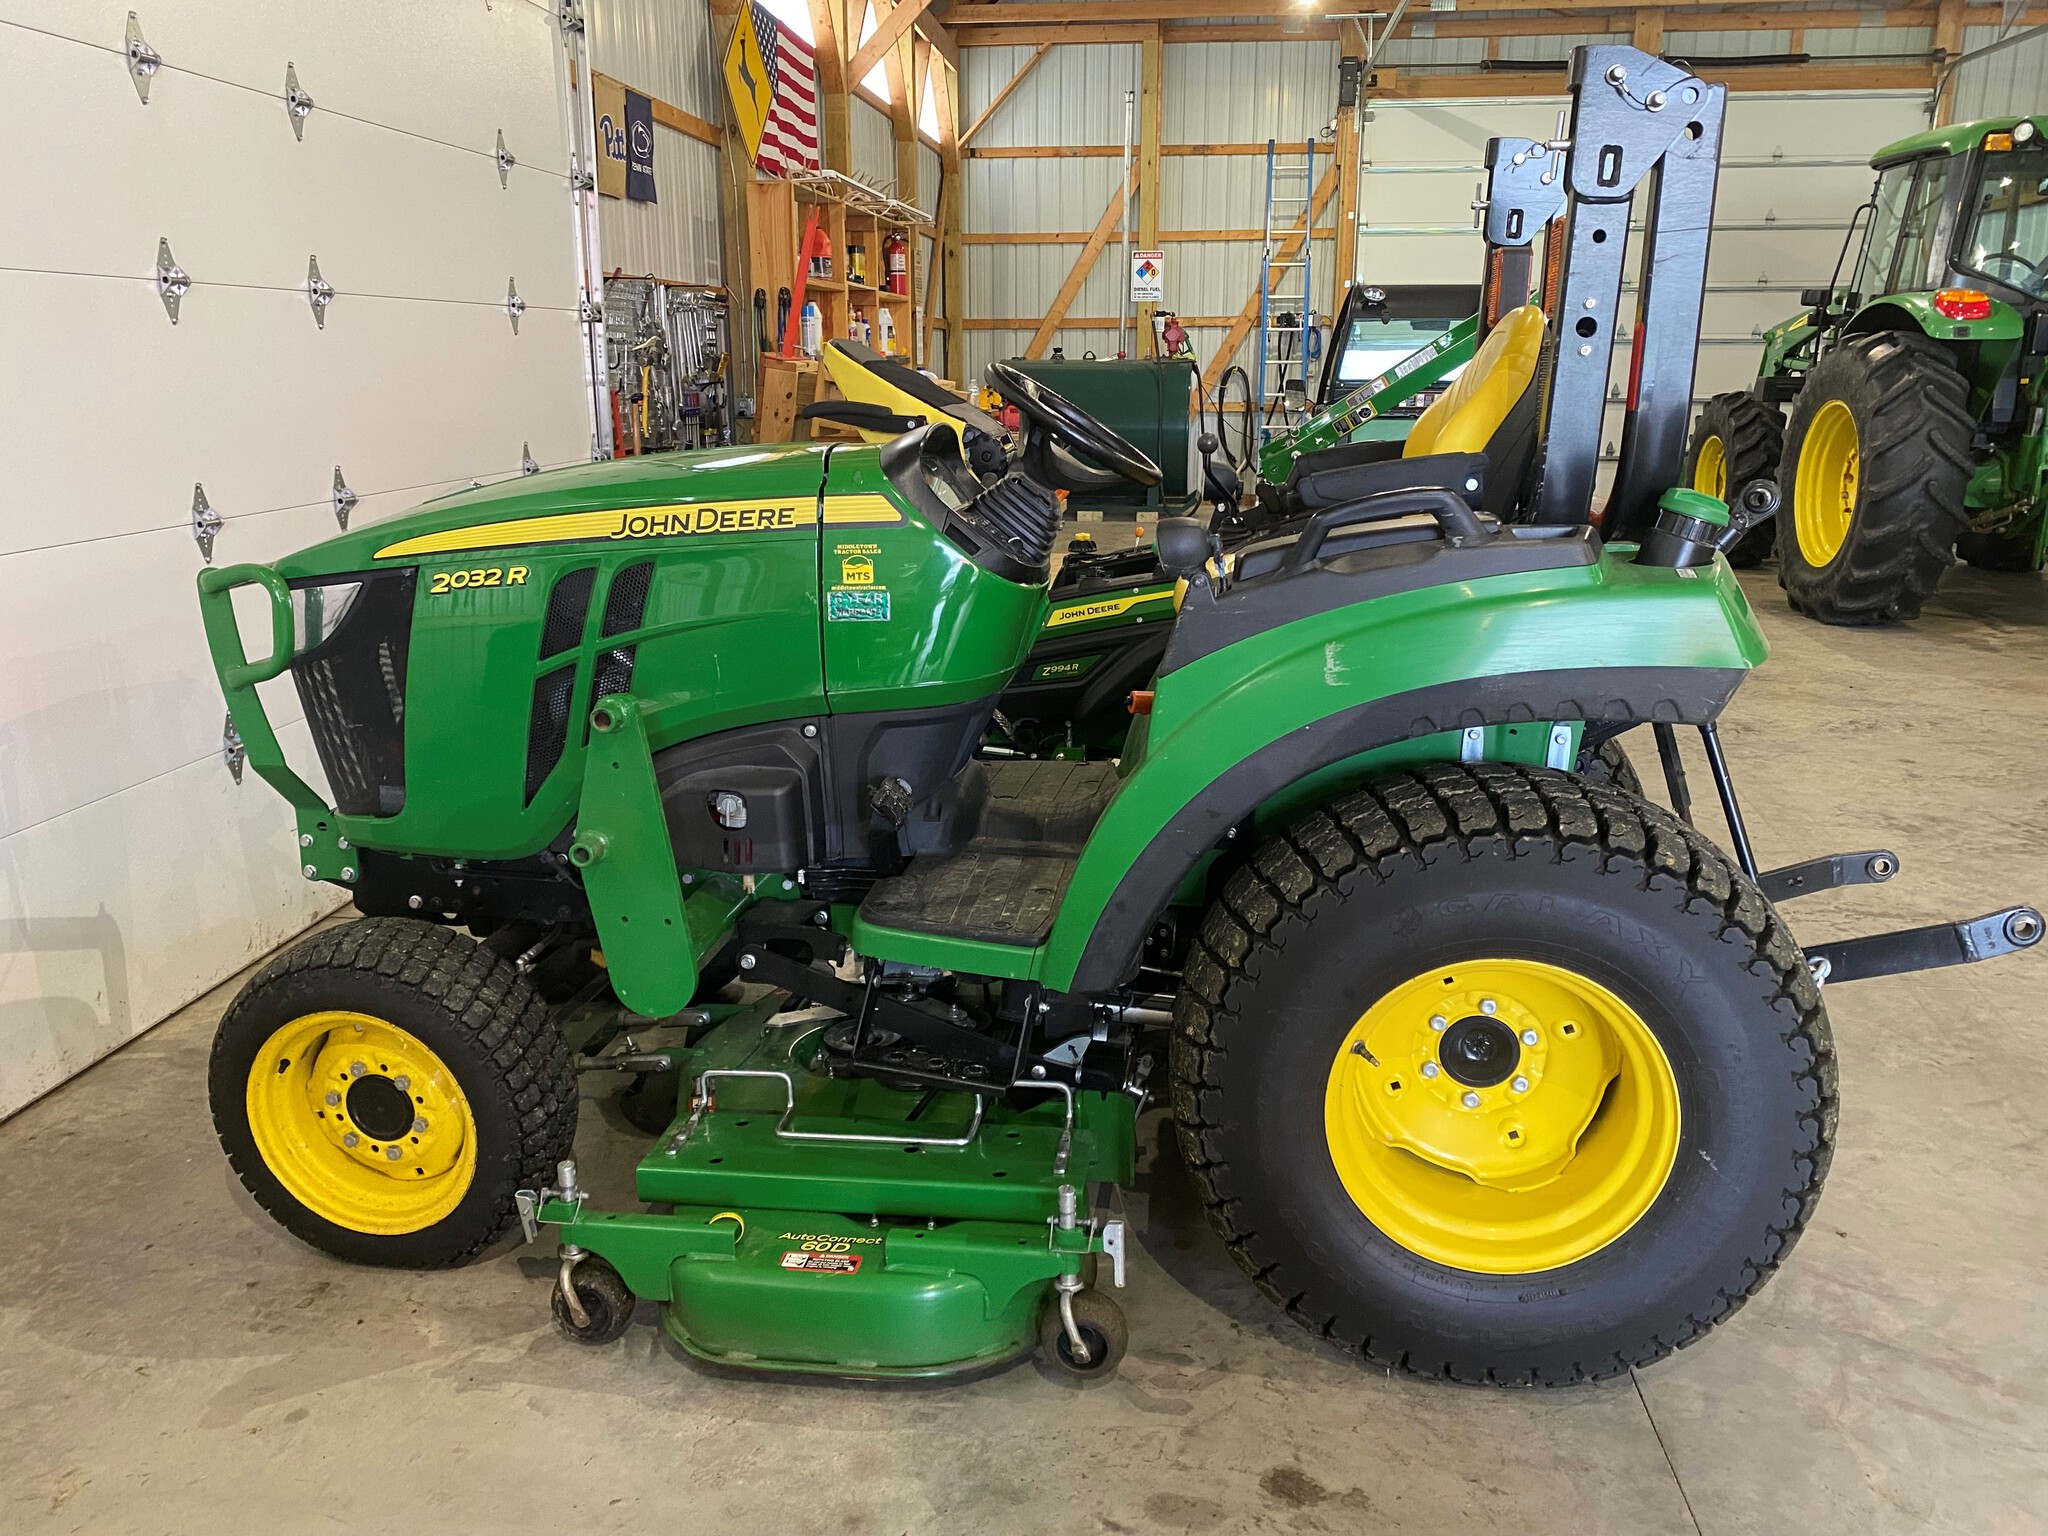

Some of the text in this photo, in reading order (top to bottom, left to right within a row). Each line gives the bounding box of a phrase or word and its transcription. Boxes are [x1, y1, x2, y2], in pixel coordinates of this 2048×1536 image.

[1151, 268, 1156, 276] 0
[610, 507, 796, 537] JOHN DEERE
[430, 566, 528, 595] 2032 R
[846, 572, 870, 581] MTS
[1059, 603, 1121, 620] JOHN DEERE
[778, 1232, 883, 1245] AutoConnect
[800, 1240, 851, 1253] 60D
